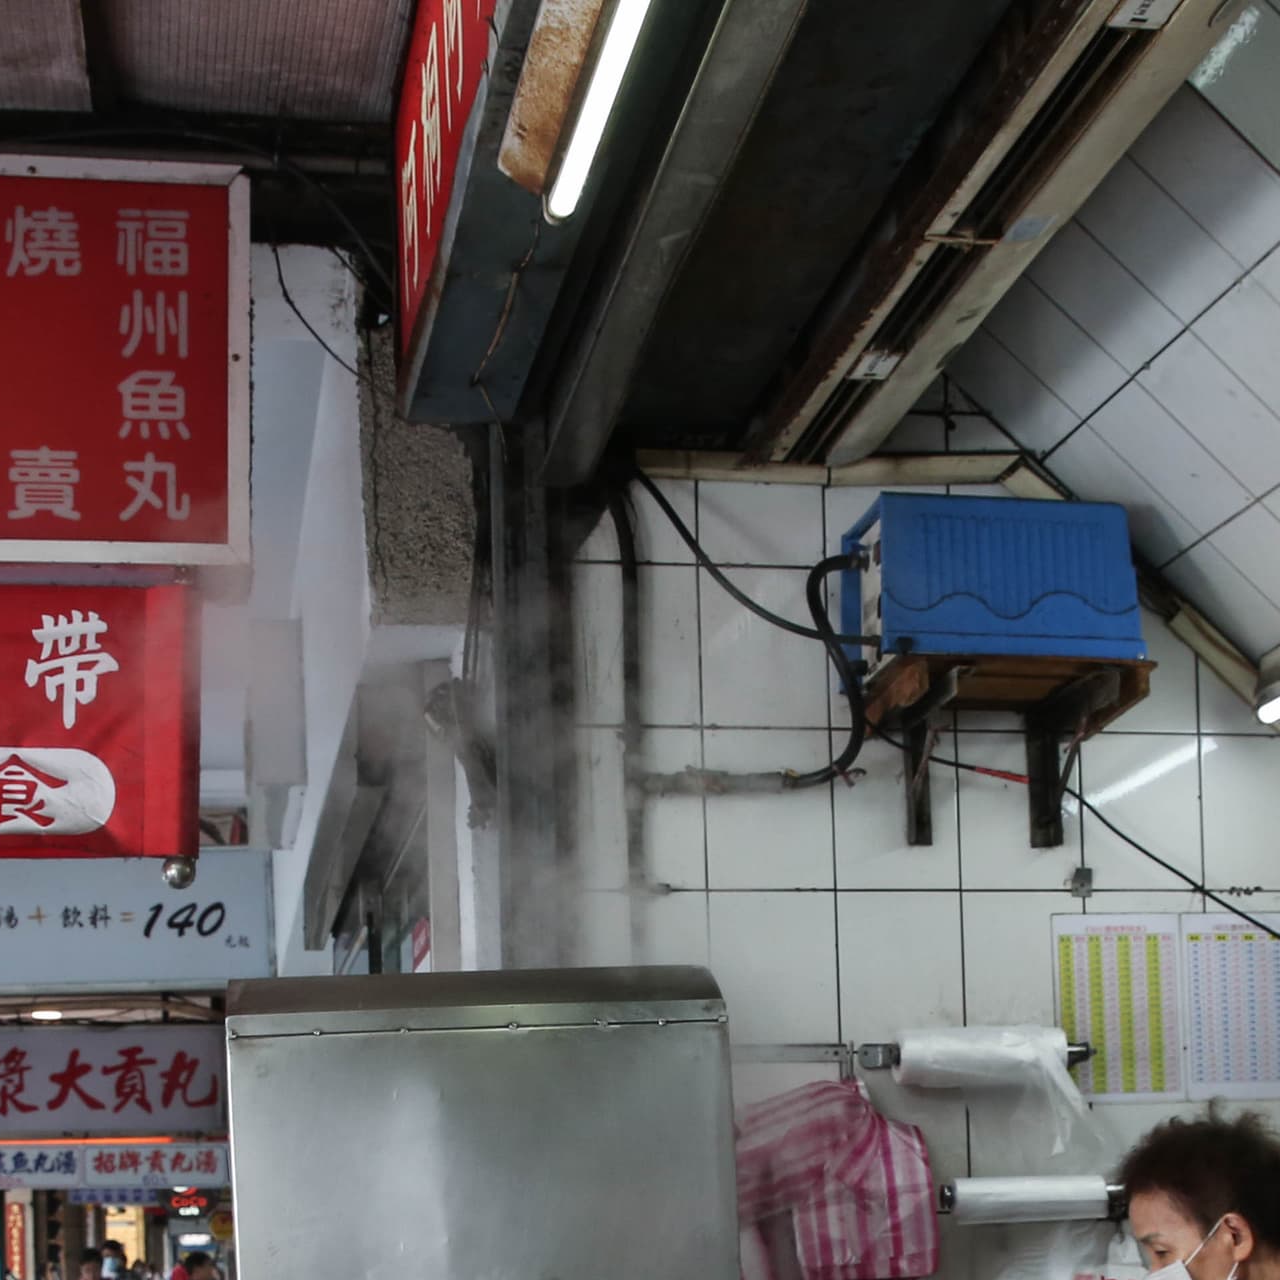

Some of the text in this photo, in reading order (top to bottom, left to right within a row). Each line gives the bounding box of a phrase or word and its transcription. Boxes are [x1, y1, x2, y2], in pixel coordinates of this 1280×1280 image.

[116, 209, 192, 522] 福州魚丸
[142, 902, 225, 939] 140
[93, 1150, 219, 1175] 招牌貢丸湯
